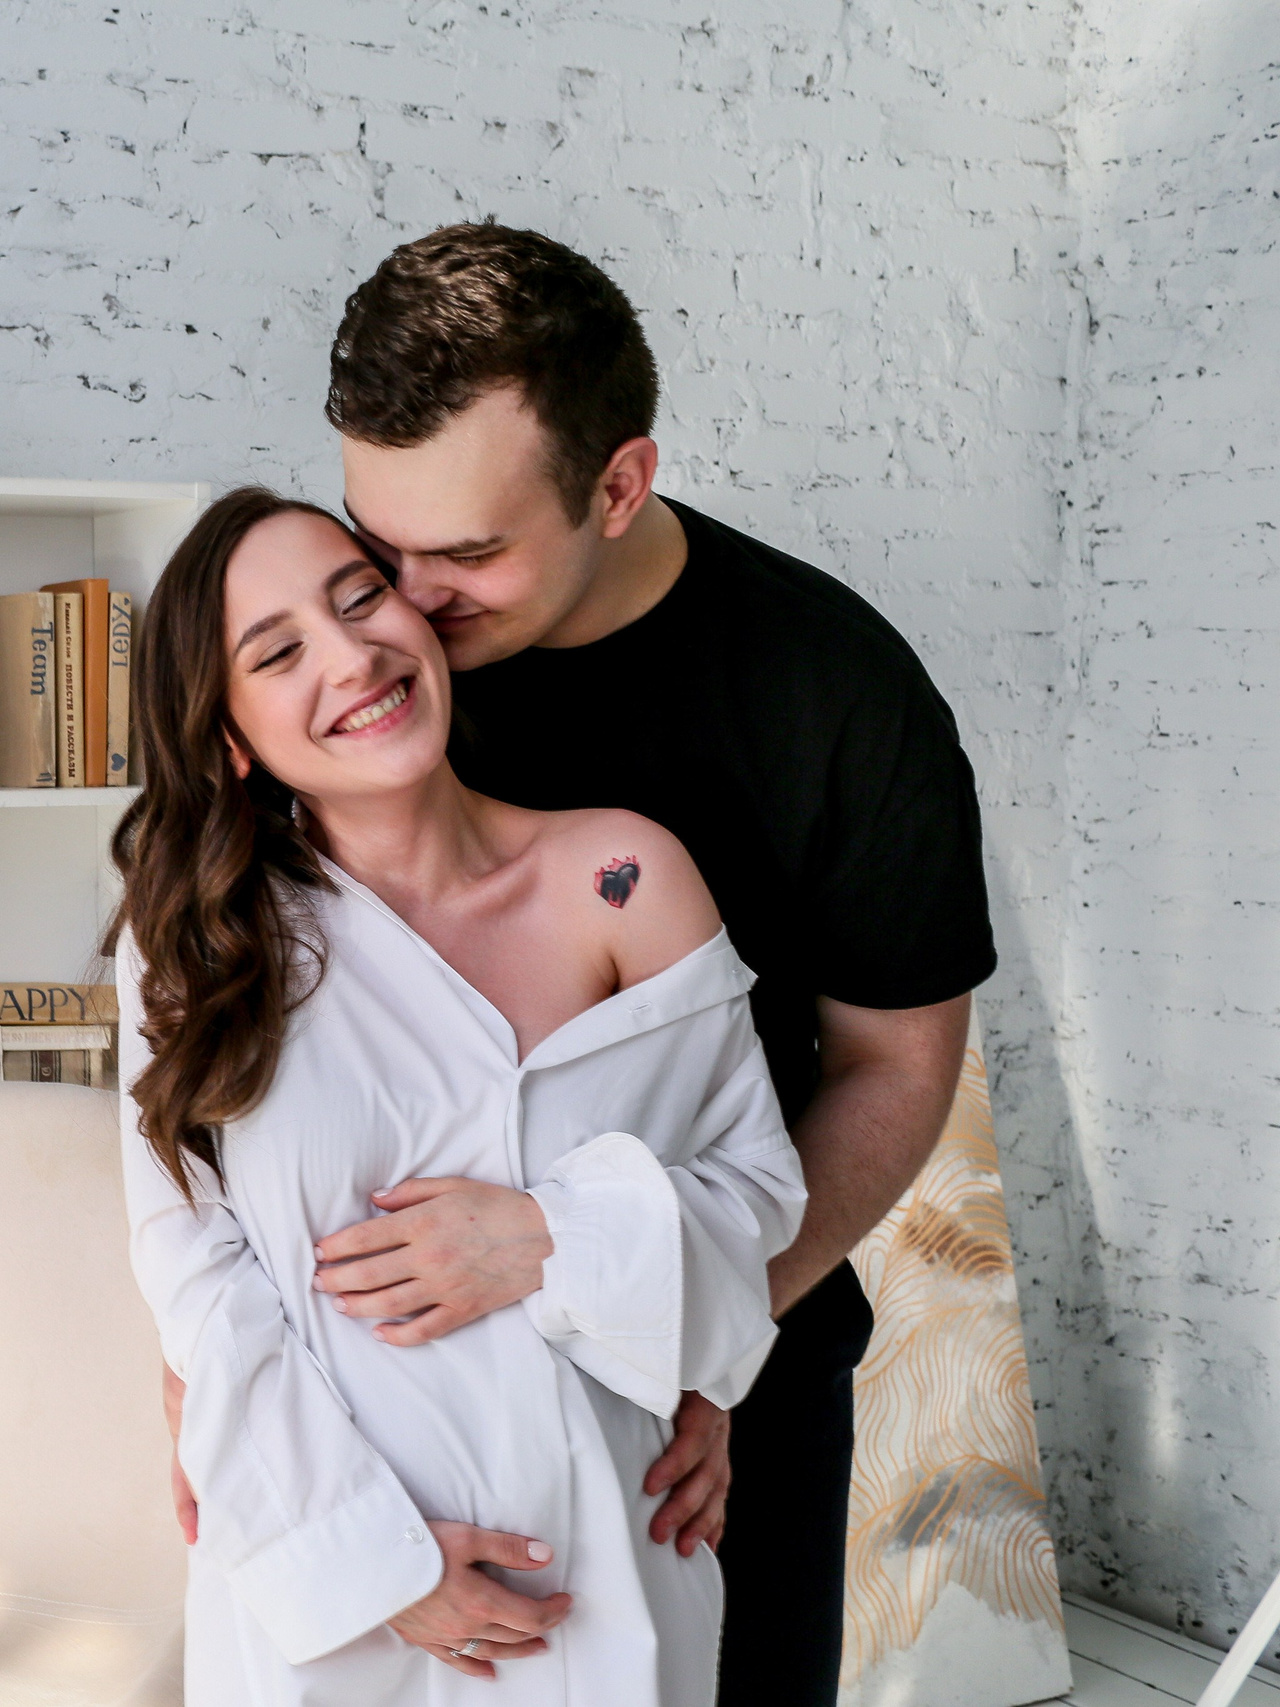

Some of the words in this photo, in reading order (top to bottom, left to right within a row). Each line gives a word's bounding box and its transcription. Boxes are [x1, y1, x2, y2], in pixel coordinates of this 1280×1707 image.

[30, 621, 54, 696] Team
[65, 664, 74, 711] ПОВЕСТИ
[66, 725, 76, 778] РАССКАЗЫ
